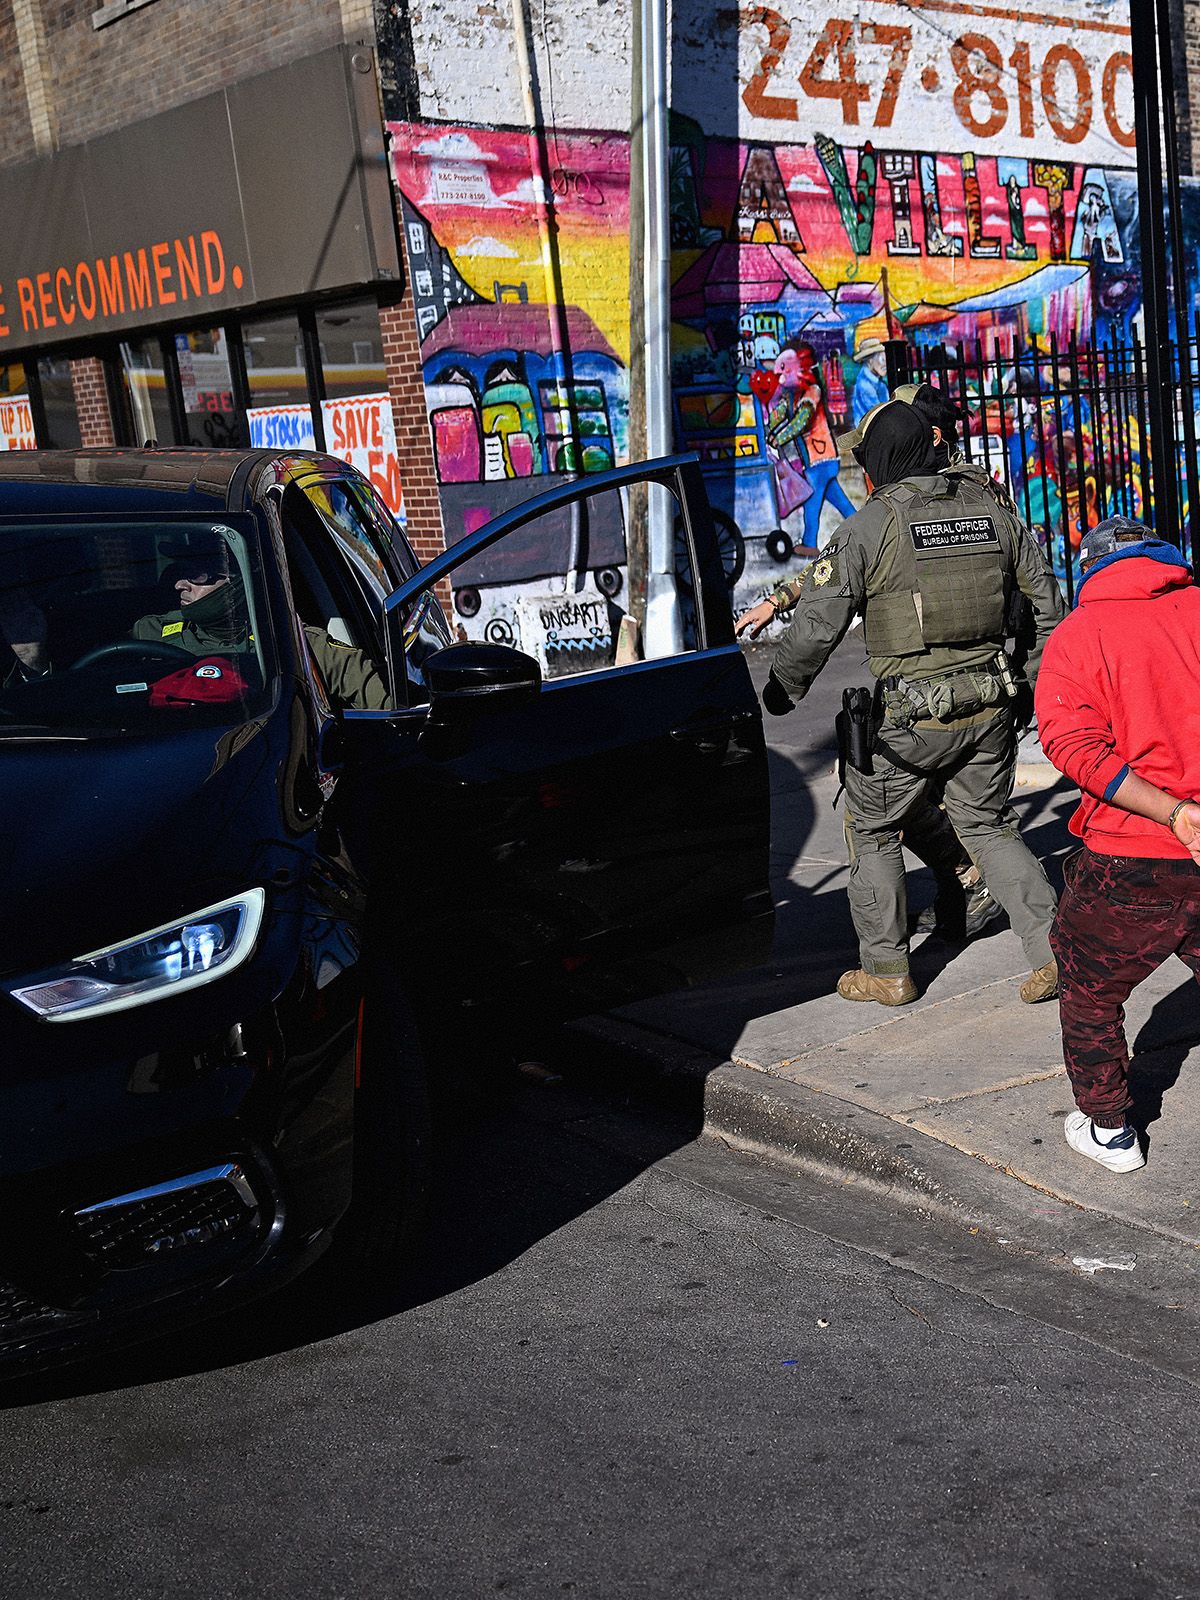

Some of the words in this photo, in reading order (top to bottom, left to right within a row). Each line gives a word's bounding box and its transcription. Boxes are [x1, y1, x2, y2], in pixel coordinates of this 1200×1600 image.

[454, 173, 483, 182] Properties
[814, 131, 1123, 264] VILLITA
[17, 230, 243, 332] RECOMMEND.
[265, 414, 300, 448] STOCK
[333, 406, 383, 450] SAVE
[915, 523, 954, 537] FEDERAL
[955, 519, 990, 533] OFFICER
[922, 536, 949, 546] BUREAU
[950, 535, 960, 543] OF
[961, 532, 989, 542] PRISONS
